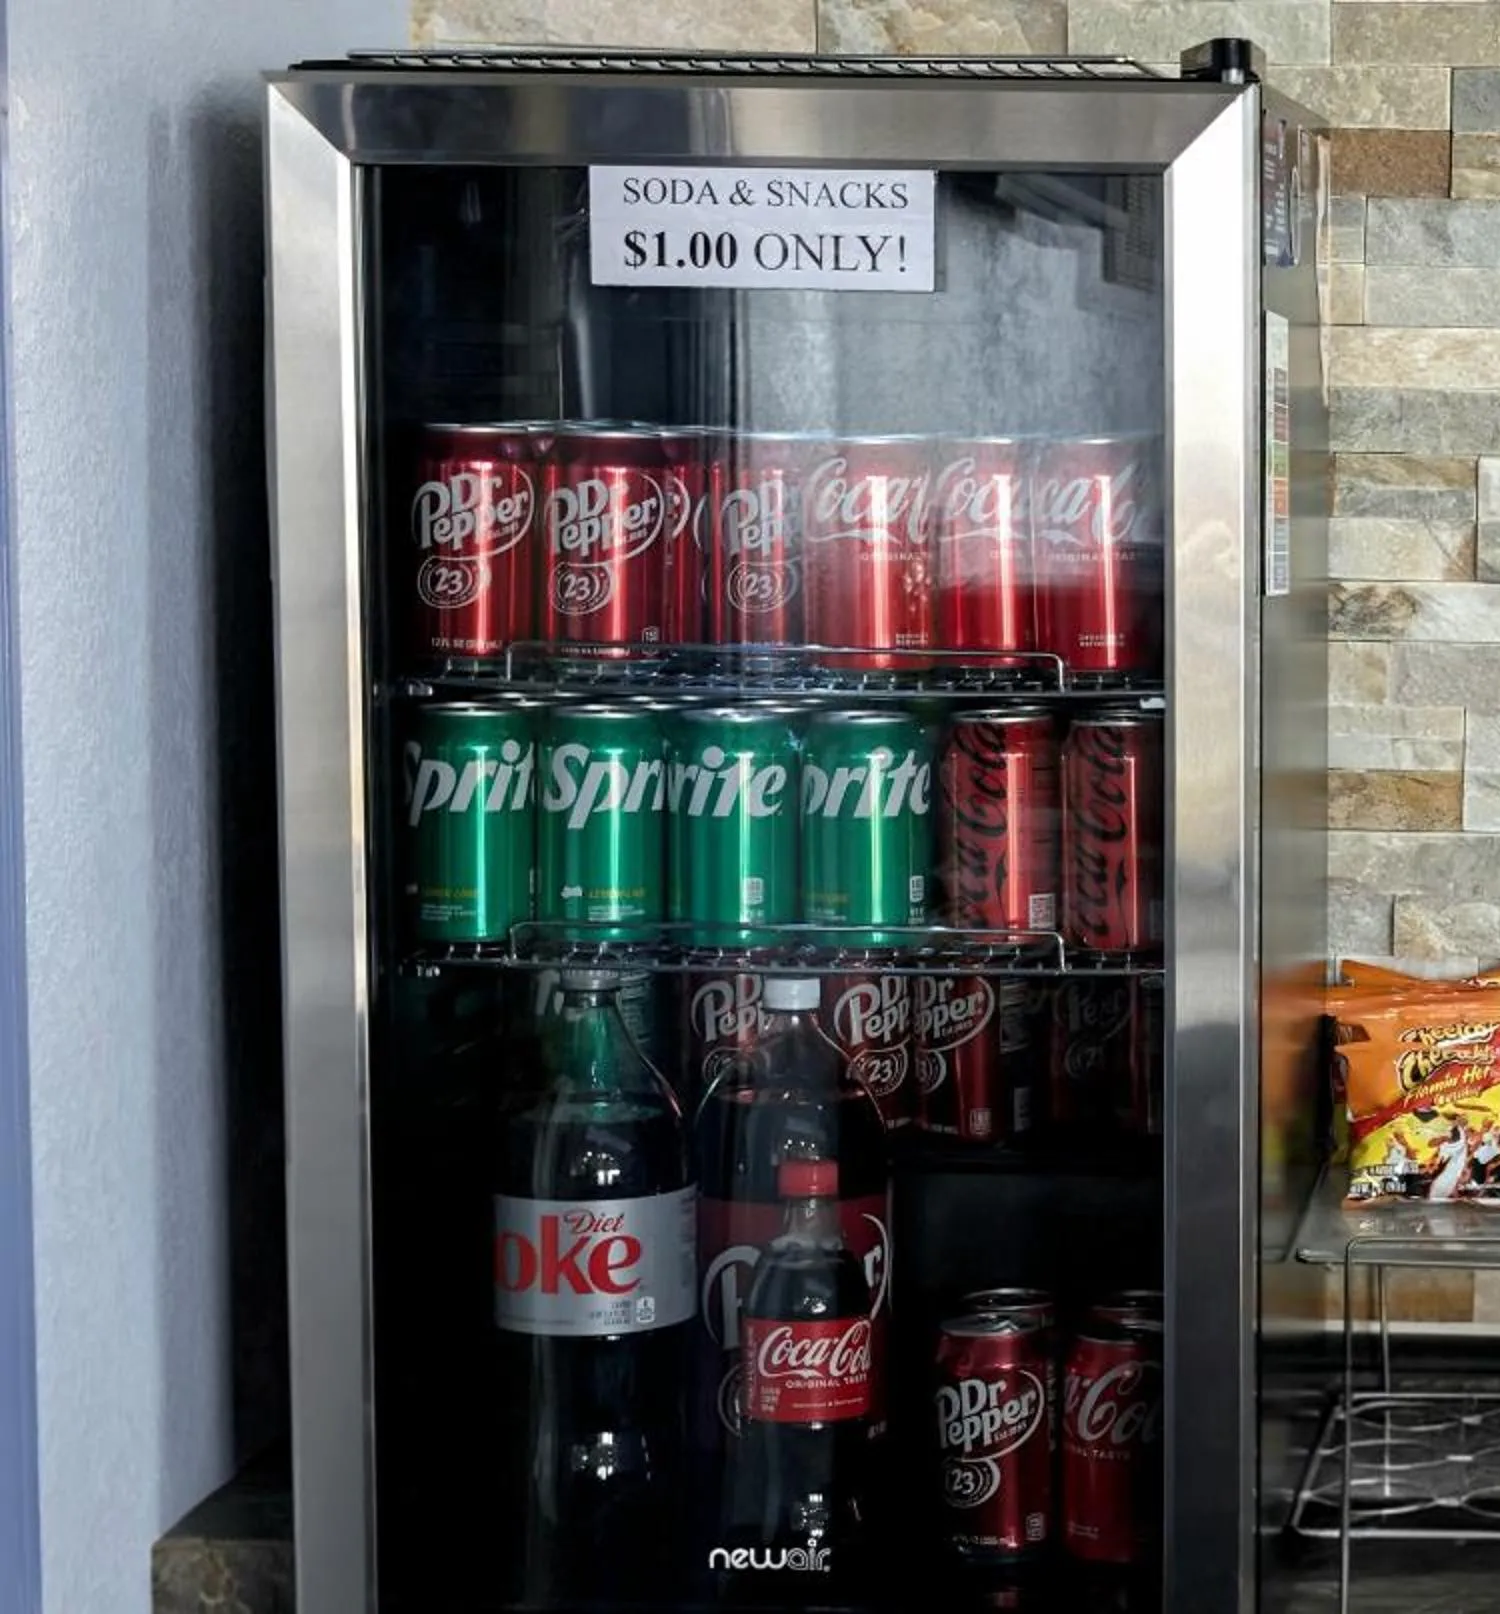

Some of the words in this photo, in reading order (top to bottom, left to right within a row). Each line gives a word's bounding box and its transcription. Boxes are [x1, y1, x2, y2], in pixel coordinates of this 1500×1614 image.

[623, 178, 720, 205] SODA
[729, 179, 753, 206] &
[767, 180, 909, 209] SNACKS
[623, 229, 738, 270] $1.00
[754, 232, 907, 273] ONLY!
[414, 480, 530, 550] Pepper
[433, 566, 463, 594] 23
[563, 575, 591, 600] 23
[563, 1209, 625, 1234] Diet
[959, 1378, 1007, 1417] Dr
[936, 1386, 1037, 1453] Pepper
[951, 1468, 975, 1494] 23
[709, 1537, 831, 1570] newair
